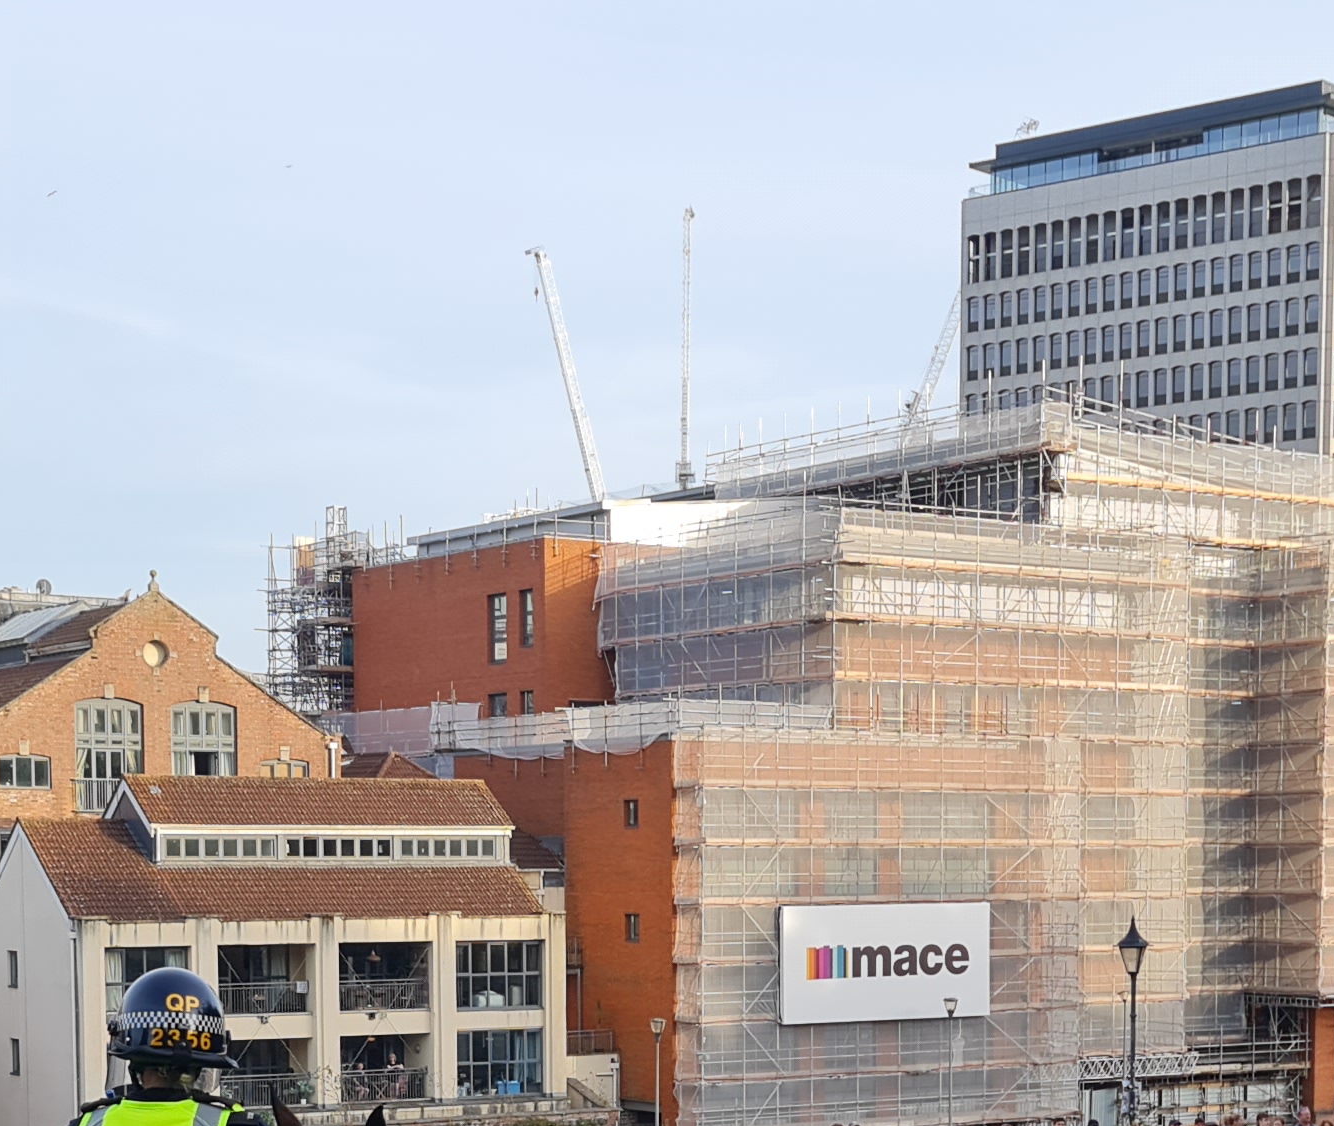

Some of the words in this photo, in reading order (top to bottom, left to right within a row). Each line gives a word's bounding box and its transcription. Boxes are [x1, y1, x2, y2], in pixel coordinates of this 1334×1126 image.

[852, 943, 970, 978] mace
[166, 993, 201, 1012] QP
[150, 1028, 212, 1050] 2356
